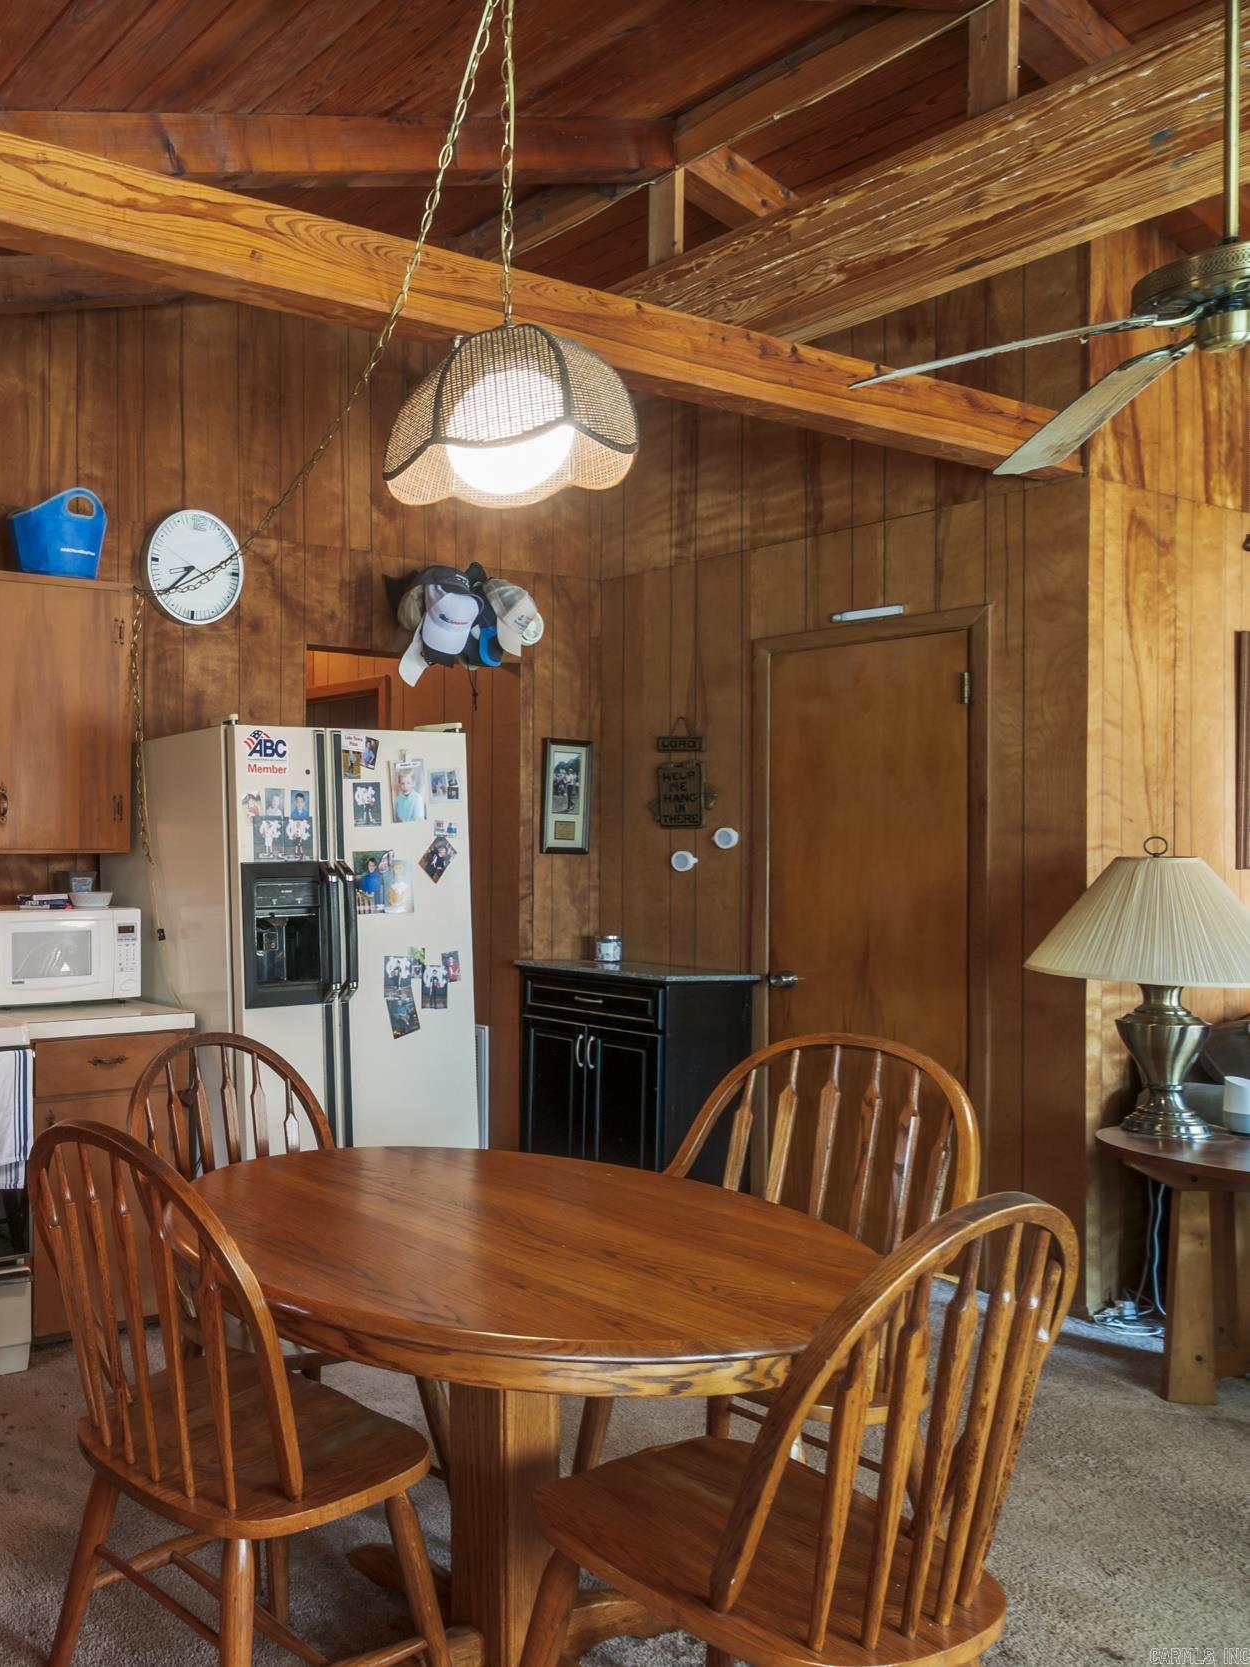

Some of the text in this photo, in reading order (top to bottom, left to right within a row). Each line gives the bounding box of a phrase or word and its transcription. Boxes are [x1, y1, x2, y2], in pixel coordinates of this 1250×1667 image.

[248, 739, 287, 759] ABC
[661, 740, 696, 748] LORD
[247, 764, 287, 774] Member
[662, 771, 696, 781] HELP
[662, 793, 698, 802] HANG
[662, 814, 700, 824] THERE
